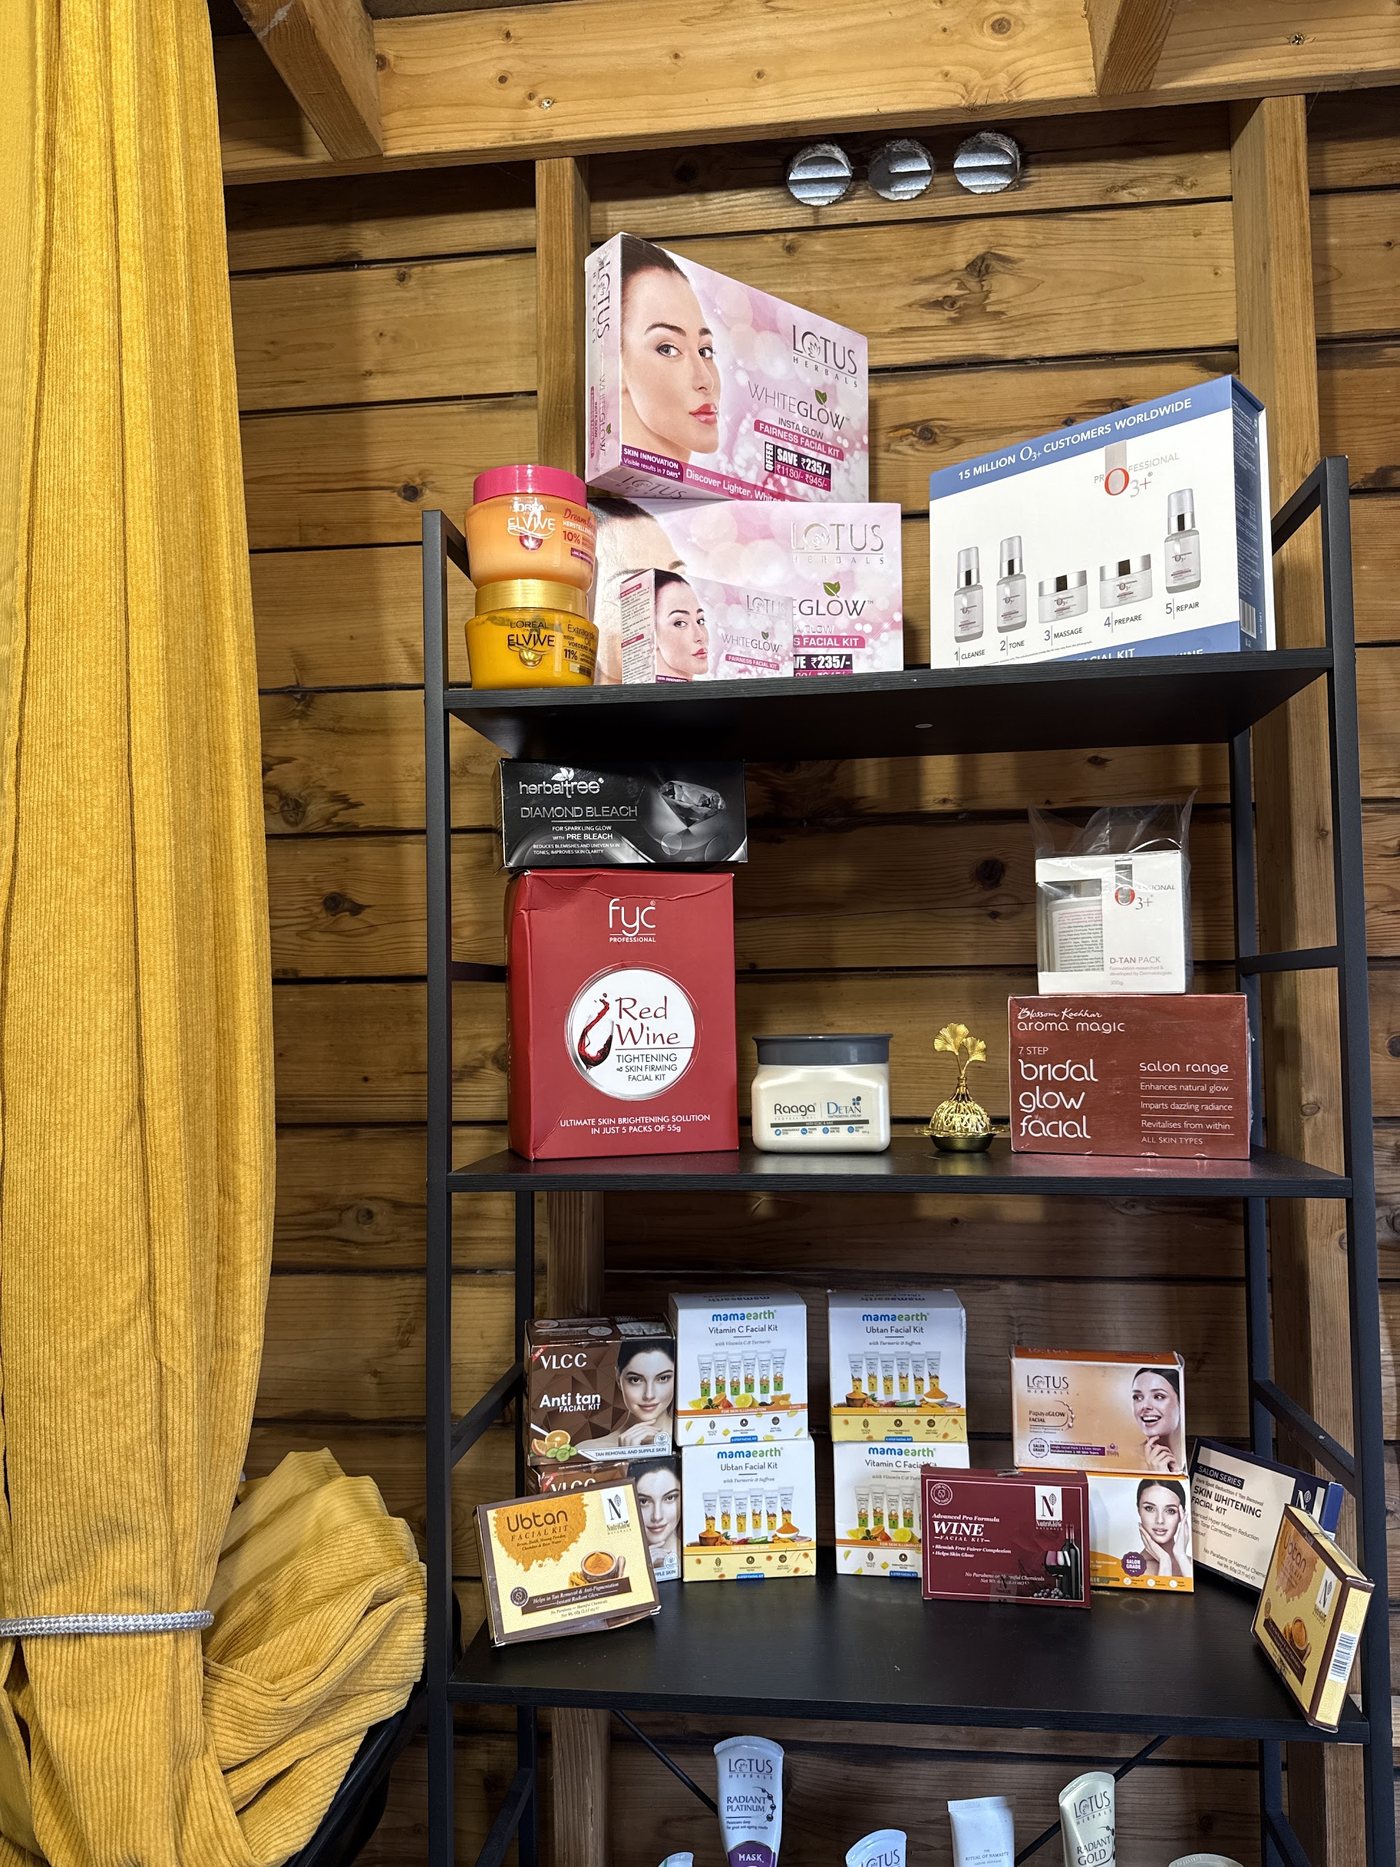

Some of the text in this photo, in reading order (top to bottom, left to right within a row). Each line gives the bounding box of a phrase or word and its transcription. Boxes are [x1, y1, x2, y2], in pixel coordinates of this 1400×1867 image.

[793, 325, 857, 375] LOTUS
[793, 356, 858, 388] HERBALS
[779, 417, 824, 440] INSTA GLOW
[759, 423, 840, 458] FAIRNESS FACIAL KIT
[958, 470, 971, 481] 15
[972, 454, 1016, 476] MILLION
[1043, 424, 1112, 453] CUSTOMERS
[1114, 397, 1193, 431] WORLDWIDE
[623, 448, 679, 469] SKIN INNOVATION
[765, 443, 774, 471] OFFER
[777, 448, 798, 466] SAVE
[686, 469, 721, 488] Discover
[508, 517, 556, 531] ELVIVE
[563, 531, 580, 544] 10%
[791, 523, 884, 552] LOTUS
[1165, 601, 1200, 615] 5 REPAIR
[1103, 614, 1143, 628] 4 PREPARE
[508, 634, 555, 647] ELVIVE
[1044, 627, 1083, 641] 3 MASSAGE
[803, 637, 859, 647] FACIAL KIT
[999, 640, 1025, 651] 2 TONE
[564, 649, 578, 660] 11%
[954, 651, 959, 661] 1
[961, 649, 986, 660] CLEANSE
[1116, 648, 1136, 658] KIT
[728, 656, 752, 665] FAIRNESS
[752, 659, 770, 667] FACIAL
[521, 806, 638, 818] DIAMOND BLEACH
[609, 898, 656, 936] fyc
[615, 996, 667, 1020] Red
[1017, 1007, 1059, 1020] Blossom
[616, 1022, 680, 1046] Wine
[1017, 1021, 1125, 1034] aroma magic
[616, 1053, 678, 1063] TIGHTENING
[1018, 1047, 1049, 1055] 7 STEP
[644, 1064, 678, 1072] FIRMING
[1018, 1058, 1099, 1081] bridal
[1139, 1061, 1229, 1075] salon range
[628, 1073, 666, 1082] FACIAL KIT
[1140, 1082, 1229, 1093] Enhances natural glow
[1019, 1085, 1085, 1113] glow
[774, 1103, 815, 1116] Raaga
[1140, 1101, 1233, 1112] Imparts dazzling radiance
[560, 1114, 711, 1127] ULTIMATE SKIN BRIGHTENING SOLUTION
[1020, 1115, 1091, 1138] facial
[1141, 1120, 1231, 1130] Revitalises from within
[602, 1126, 620, 1134] JUST
[628, 1125, 653, 1133] PACKS
[1179, 1137, 1203, 1145] TYPES
[712, 1310, 774, 1321] mamaearth
[862, 1313, 928, 1322] mamaearth
[738, 1325, 744, 1333] C
[746, 1324, 766, 1333] Facial
[541, 1353, 587, 1369] VLCC
[1027, 1375, 1069, 1389] LOTUS
[539, 1392, 600, 1408] Anti tan
[559, 1404, 586, 1413] FACIAL
[717, 1448, 781, 1459] mamaearth
[868, 1447, 934, 1457] mamaearth
[720, 1463, 743, 1471] Ubtan
[745, 1462, 766, 1470] Facial
[865, 1459, 893, 1467] Vitamin
[1198, 1465, 1242, 1487] SALON SERIES
[1192, 1496, 1227, 1515] FACIAL KIT
[1194, 1485, 1262, 1518] SKIN WHITENING
[507, 1510, 568, 1532] Ubtan
[511, 1525, 569, 1541] FACIAL KIT
[933, 1521, 984, 1536] WINE
[728, 1758, 773, 1773] LOTUS
[727, 1796, 767, 1804] RADIANT
[1073, 1791, 1110, 1818] LOTUS
[727, 1804, 765, 1812] PLATINUM
[1077, 1835, 1111, 1854] RADIANT
[738, 1853, 762, 1862] MASK
[1077, 1849, 1106, 1866] GOLD
